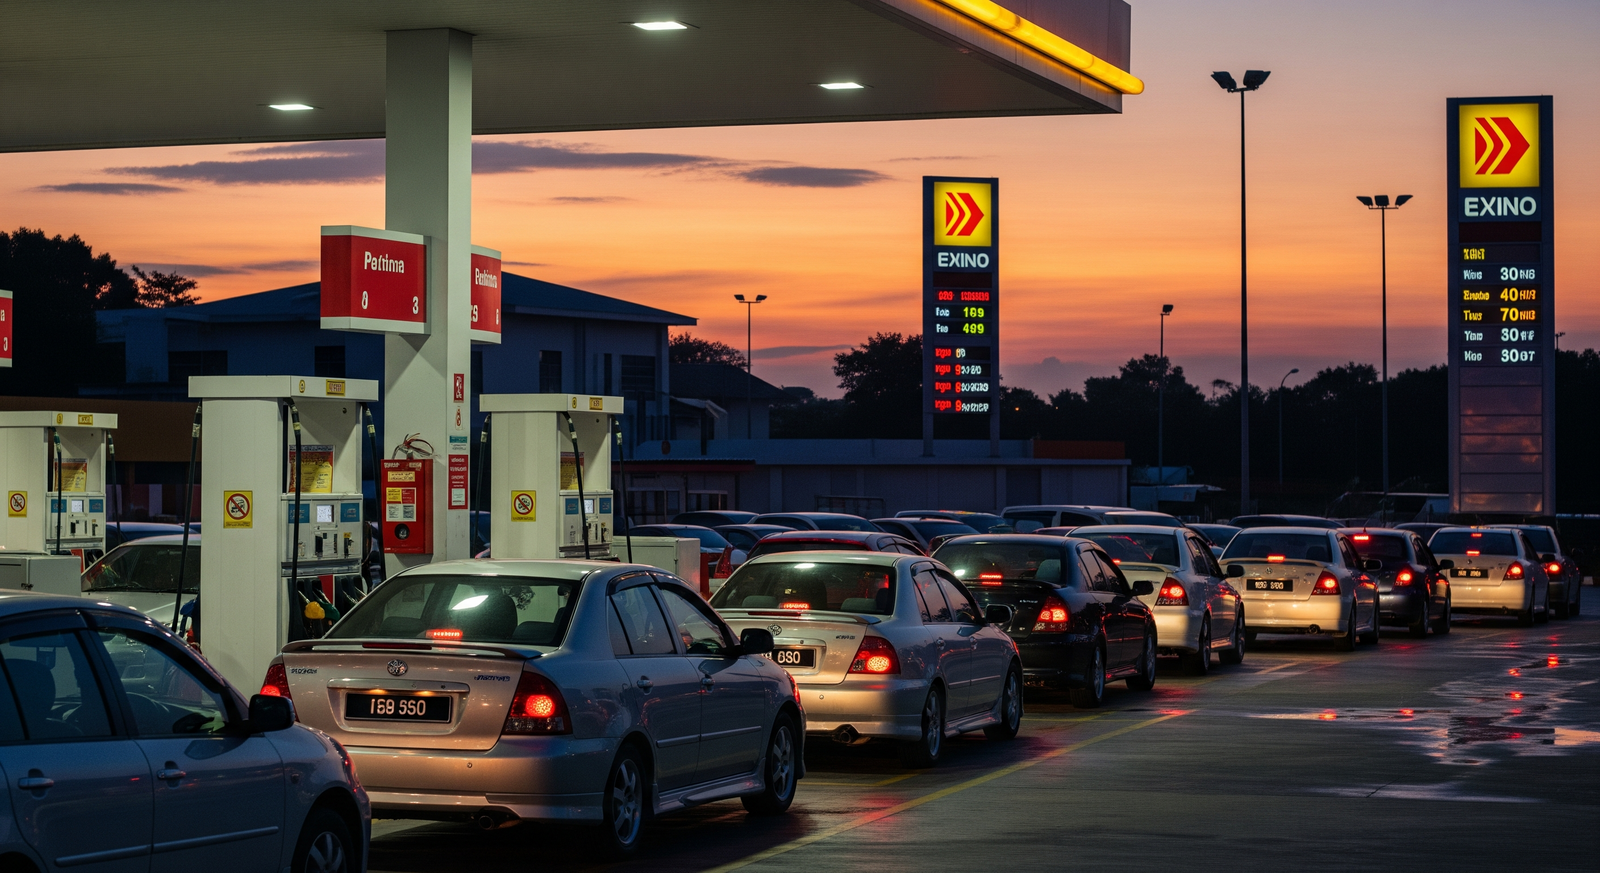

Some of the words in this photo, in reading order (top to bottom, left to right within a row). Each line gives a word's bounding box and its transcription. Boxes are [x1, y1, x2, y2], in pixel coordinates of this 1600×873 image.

[1464, 196, 1537, 217] EXINO
[937, 252, 990, 268] EXINO
[412, 296, 419, 315] 3
